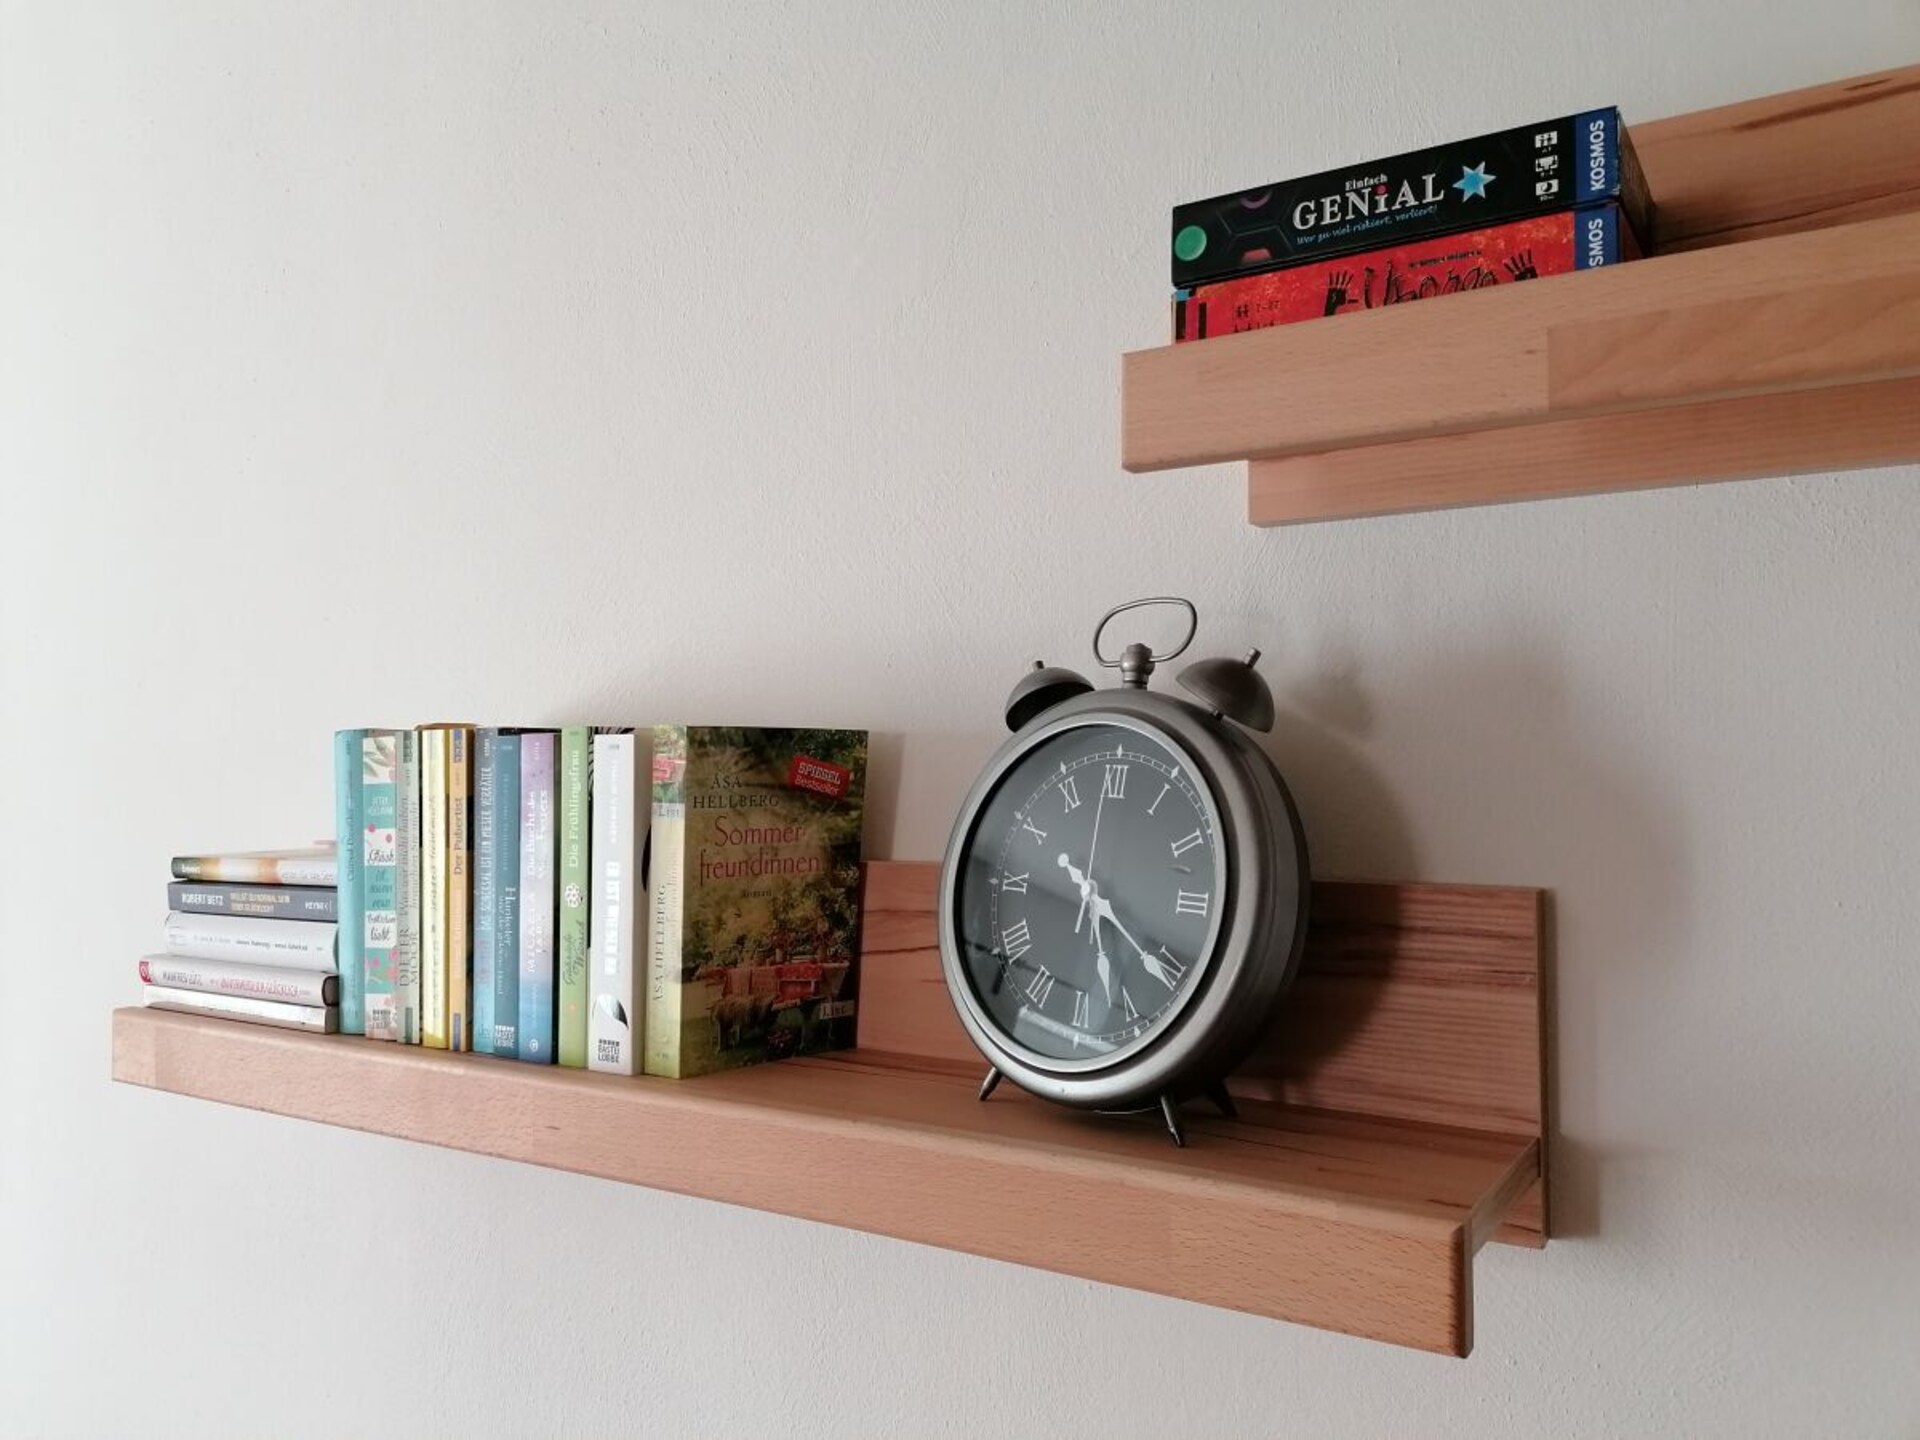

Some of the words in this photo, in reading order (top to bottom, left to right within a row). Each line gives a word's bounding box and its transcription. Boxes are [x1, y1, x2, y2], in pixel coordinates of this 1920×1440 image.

[1590, 119, 1605, 191] KOSMOS
[1345, 173, 1388, 191] Einfach
[1296, 233, 1316, 245] Wer
[1317, 231, 1331, 242] zu
[1332, 225, 1351, 239] viel
[1588, 218, 1604, 267] SMOS
[711, 773, 743, 790] ÅSA
[795, 775, 839, 795] Bestseller
[798, 762, 841, 784] SPIEGEL
[568, 749, 581, 840] Frühlingsfrau
[693, 795, 780, 809] HELLBERG
[1059, 776, 1081, 813] XI
[453, 797, 464, 850] Pubertist
[479, 810, 491, 837] MIESER
[525, 812, 536, 853] Bucht
[1024, 817, 1048, 845] X
[479, 841, 491, 853] EIN
[569, 844, 579, 868] Die
[1171, 828, 1203, 857] II
[453, 854, 463, 876] Der
[479, 856, 491, 868] IST
[700, 848, 820, 887] freundinnen
[1003, 872, 1029, 894] IX
[181, 892, 206, 904] ROBERT
[1176, 889, 1209, 917] III
[654, 884, 666, 968] HELLBERG
[399, 927, 410, 987] DIETER
[408, 931, 418, 985] MOOR
[1026, 965, 1055, 1009] VII
[1073, 991, 1090, 1028] VI
